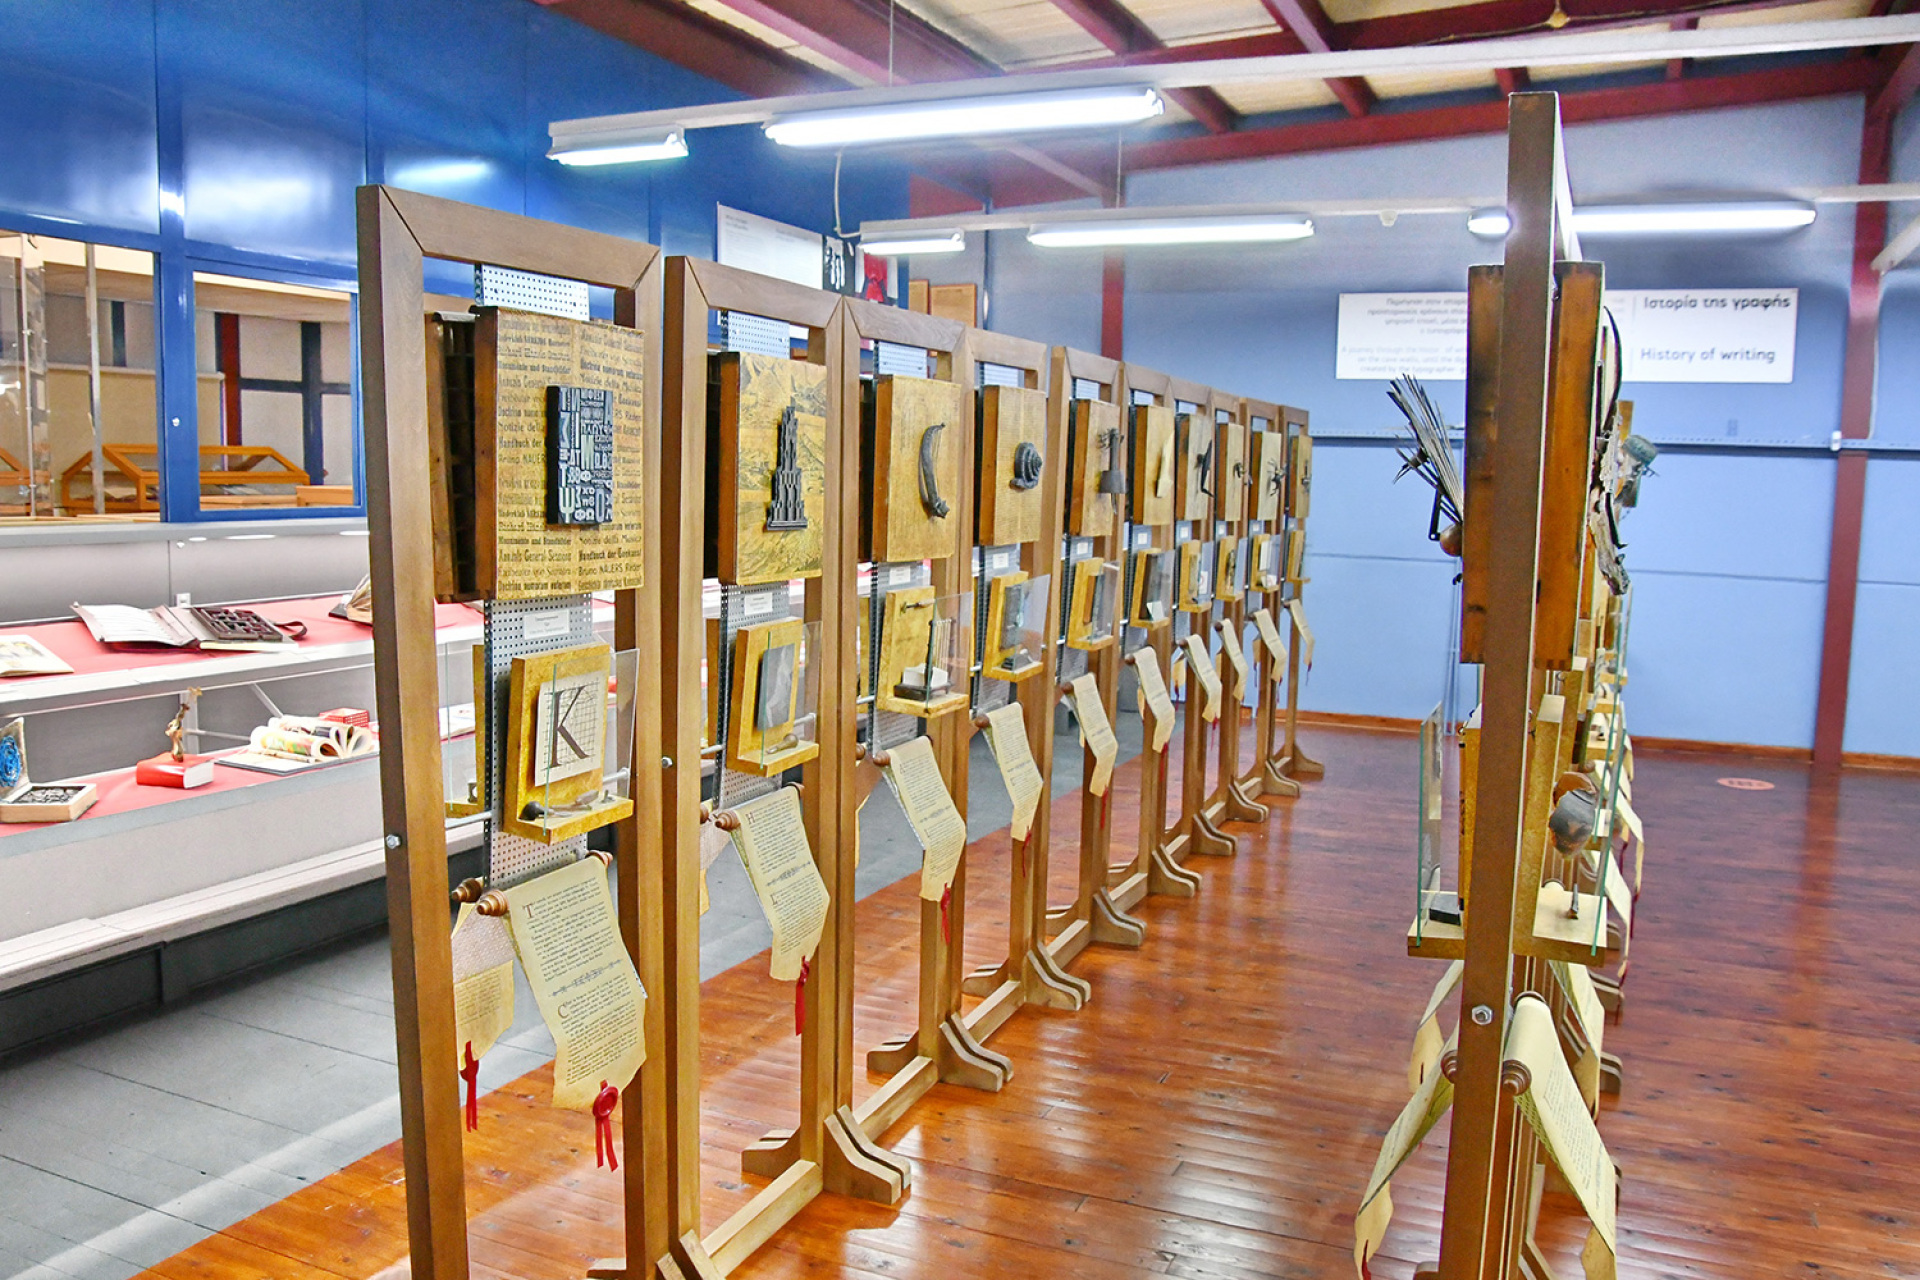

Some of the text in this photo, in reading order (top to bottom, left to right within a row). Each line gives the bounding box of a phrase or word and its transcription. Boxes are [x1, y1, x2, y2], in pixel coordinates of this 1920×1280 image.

[1644, 294, 1698, 311] Ιστορία
[1641, 347, 1776, 364] History of writing
[547, 684, 589, 768] K
